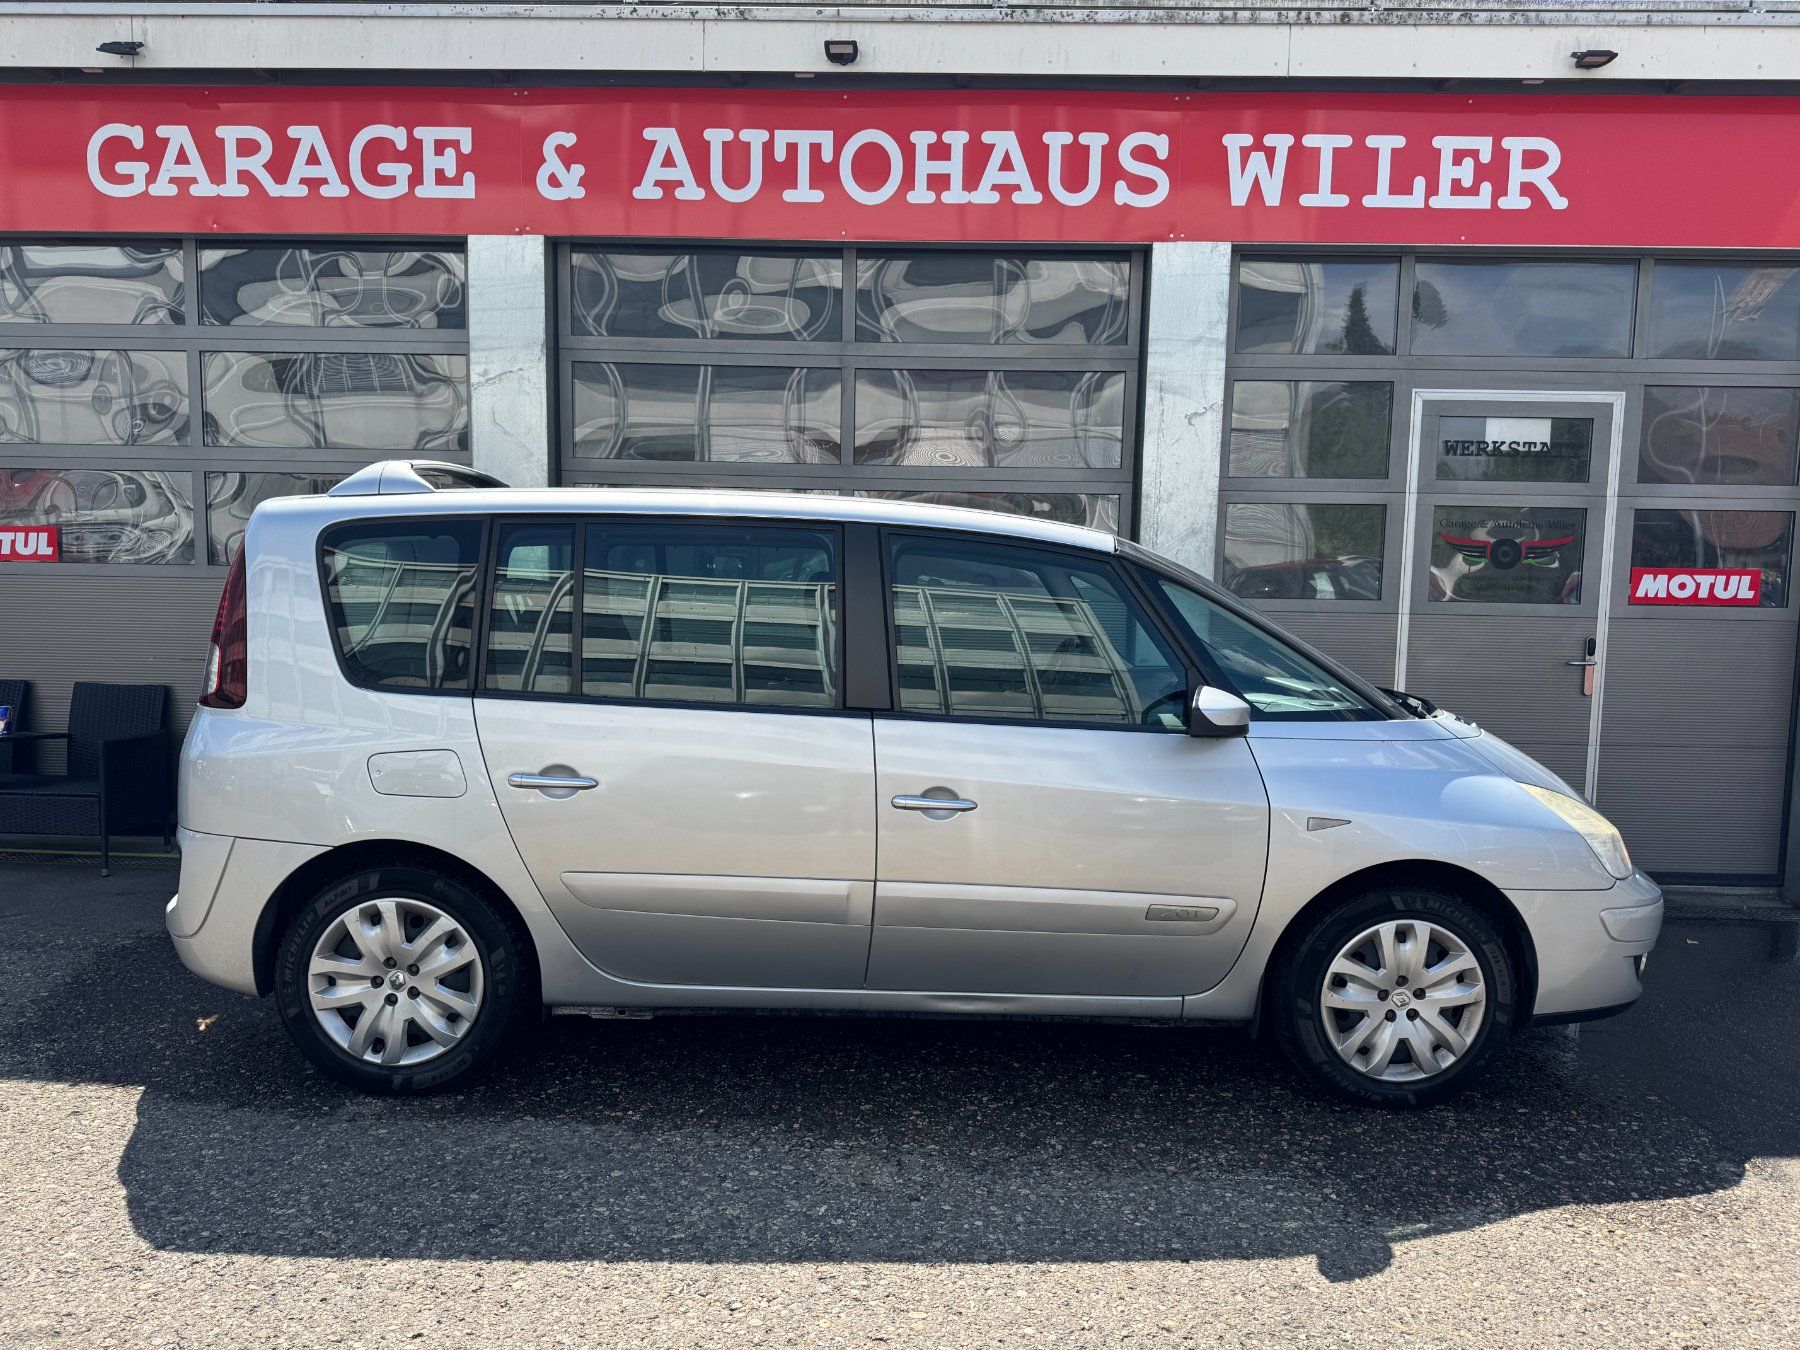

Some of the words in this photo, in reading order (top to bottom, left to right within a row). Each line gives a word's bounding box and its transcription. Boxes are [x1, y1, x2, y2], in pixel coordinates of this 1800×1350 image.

[87, 124, 475, 200] GARAGE
[537, 132, 586, 201] &
[633, 128, 1170, 208] AUTOHAUS
[1222, 134, 1569, 211] WILER
[1442, 440, 1584, 457] WERKSTA
[1439, 519, 1477, 530] Garage
[1491, 519, 1544, 530] Autohaus
[1636, 574, 1755, 599] MOTUL
